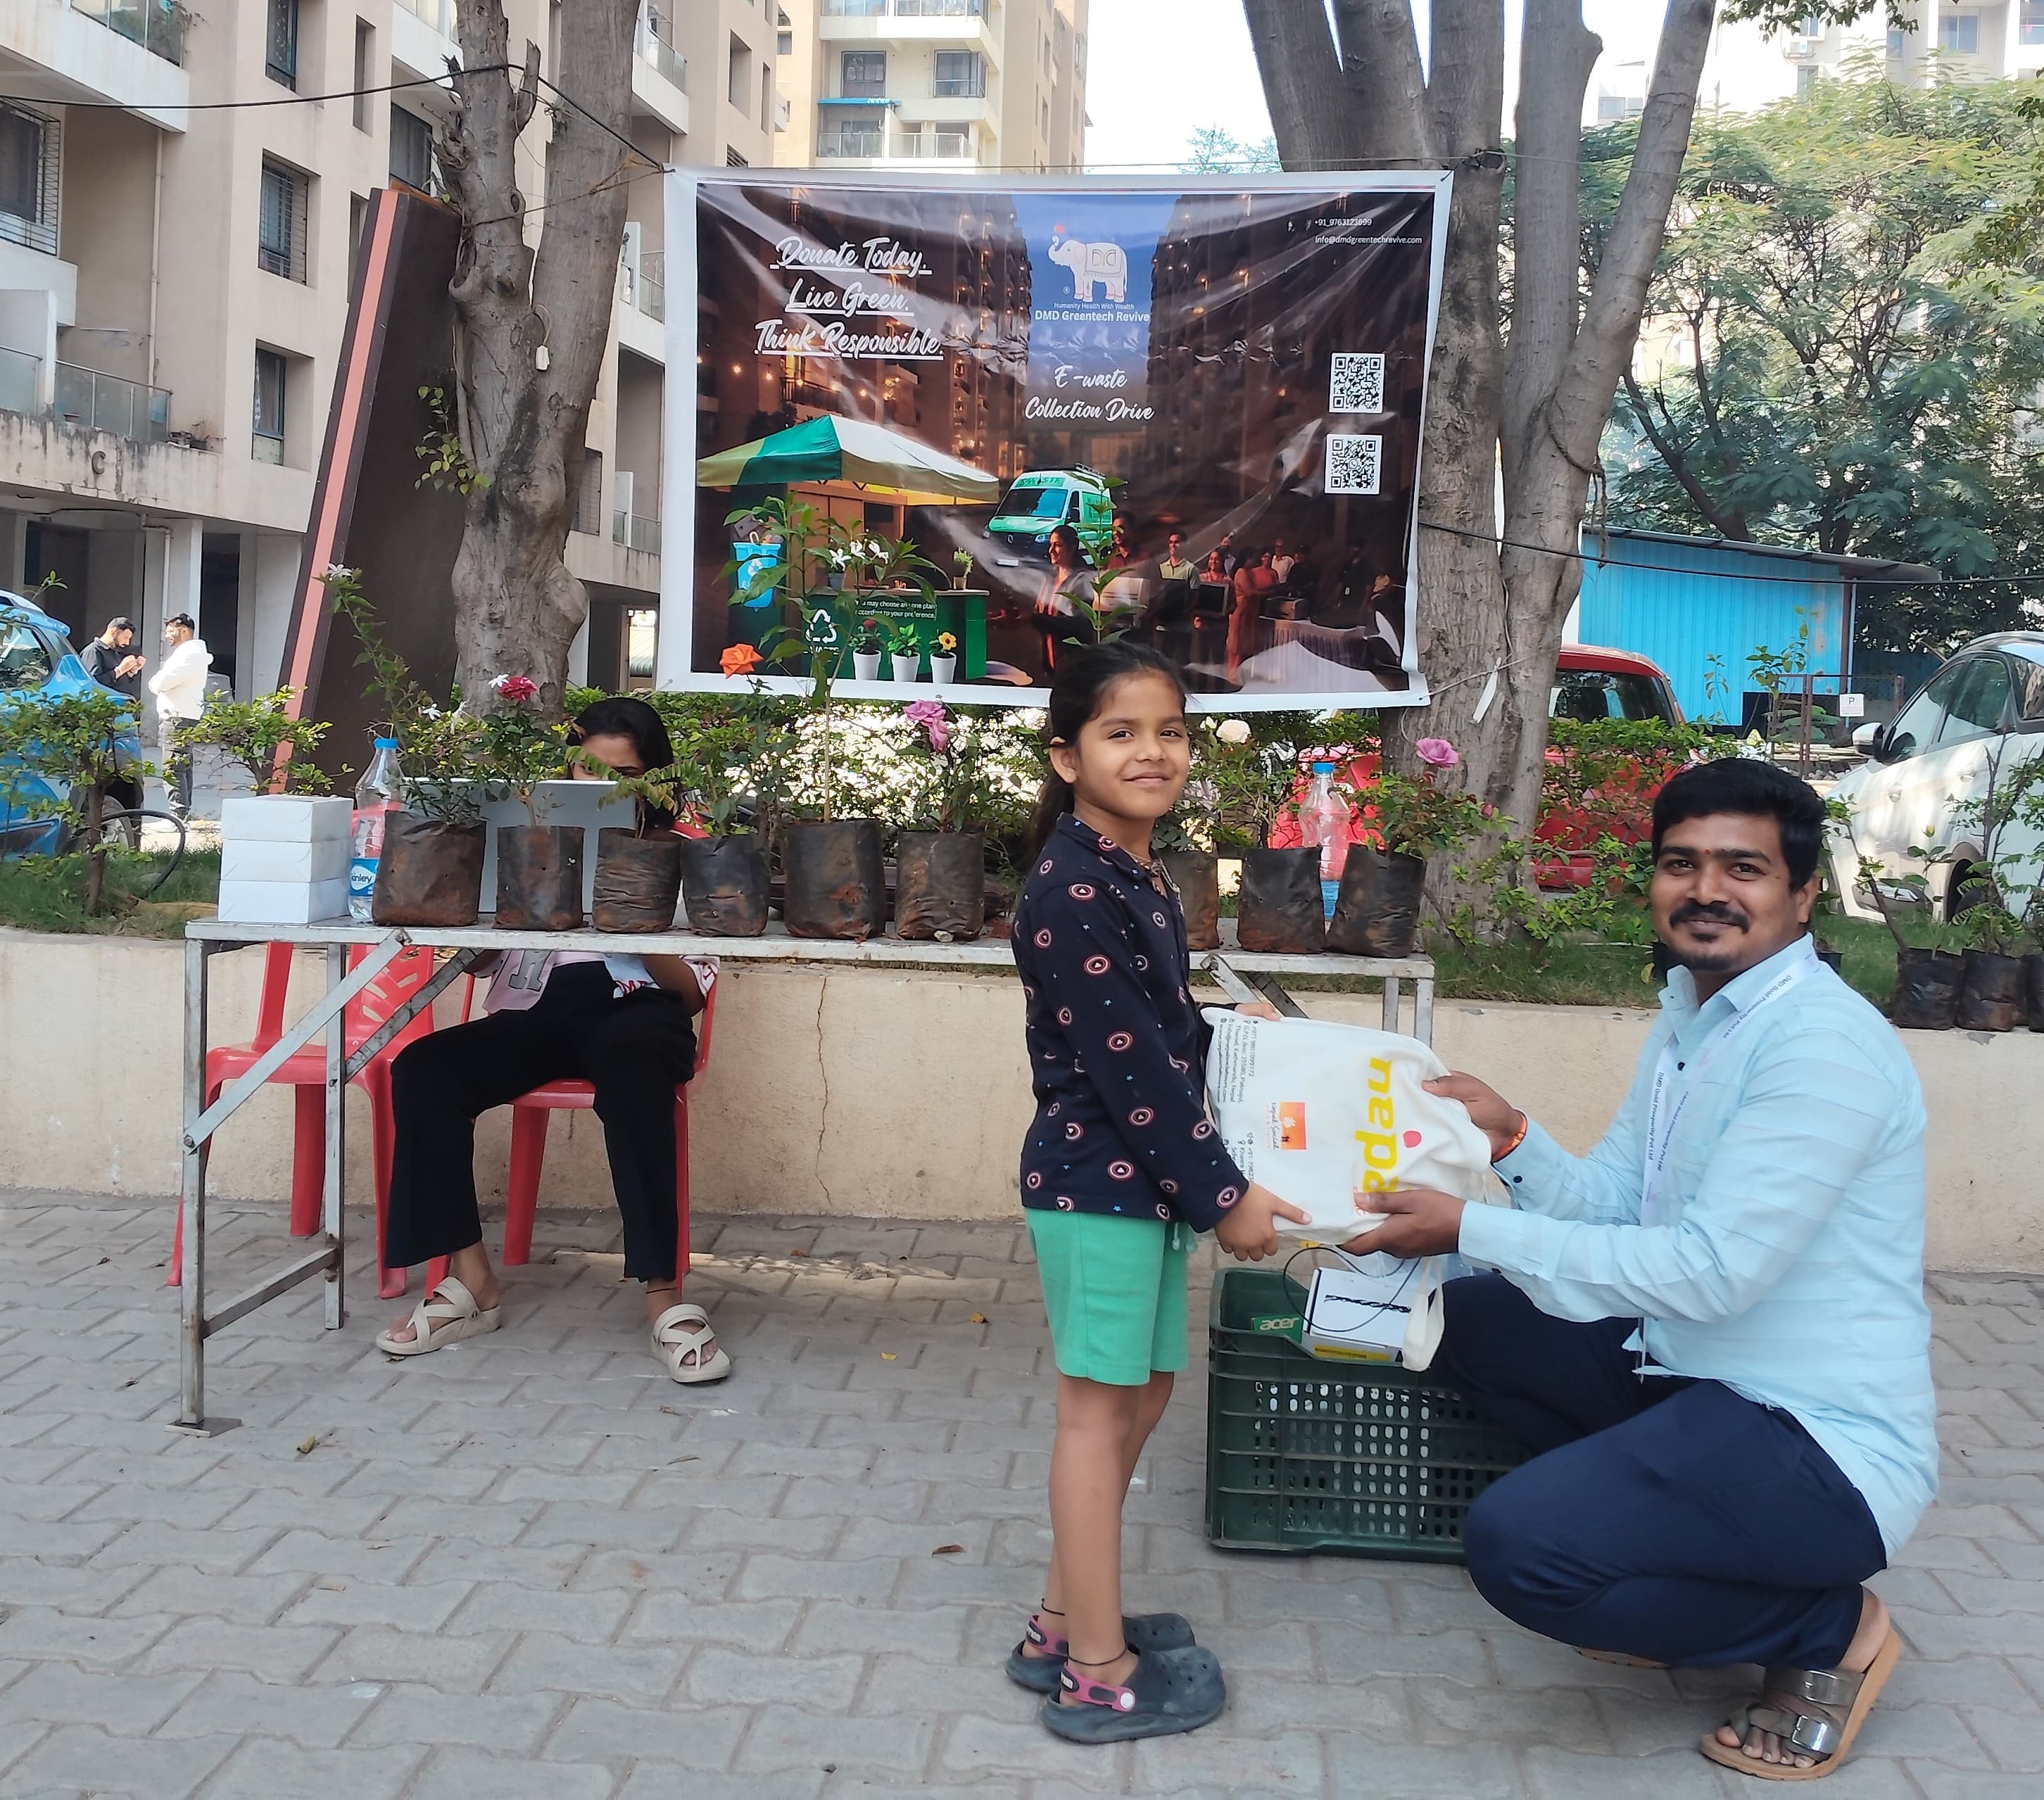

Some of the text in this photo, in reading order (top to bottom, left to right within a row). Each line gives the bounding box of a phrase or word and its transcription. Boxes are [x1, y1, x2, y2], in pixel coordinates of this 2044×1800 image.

[776, 236, 927, 277] Donate Today.
[787, 278, 909, 317] Live Green.
[1035, 310, 1150, 322] DMD Greentech Revive
[755, 319, 944, 359] Think Responsible.
[1025, 396, 1155, 422] Collection Drive
[92, 450, 106, 474] C
[1848, 697, 1855, 705] P
[1259, 1316, 1300, 1331] acer
